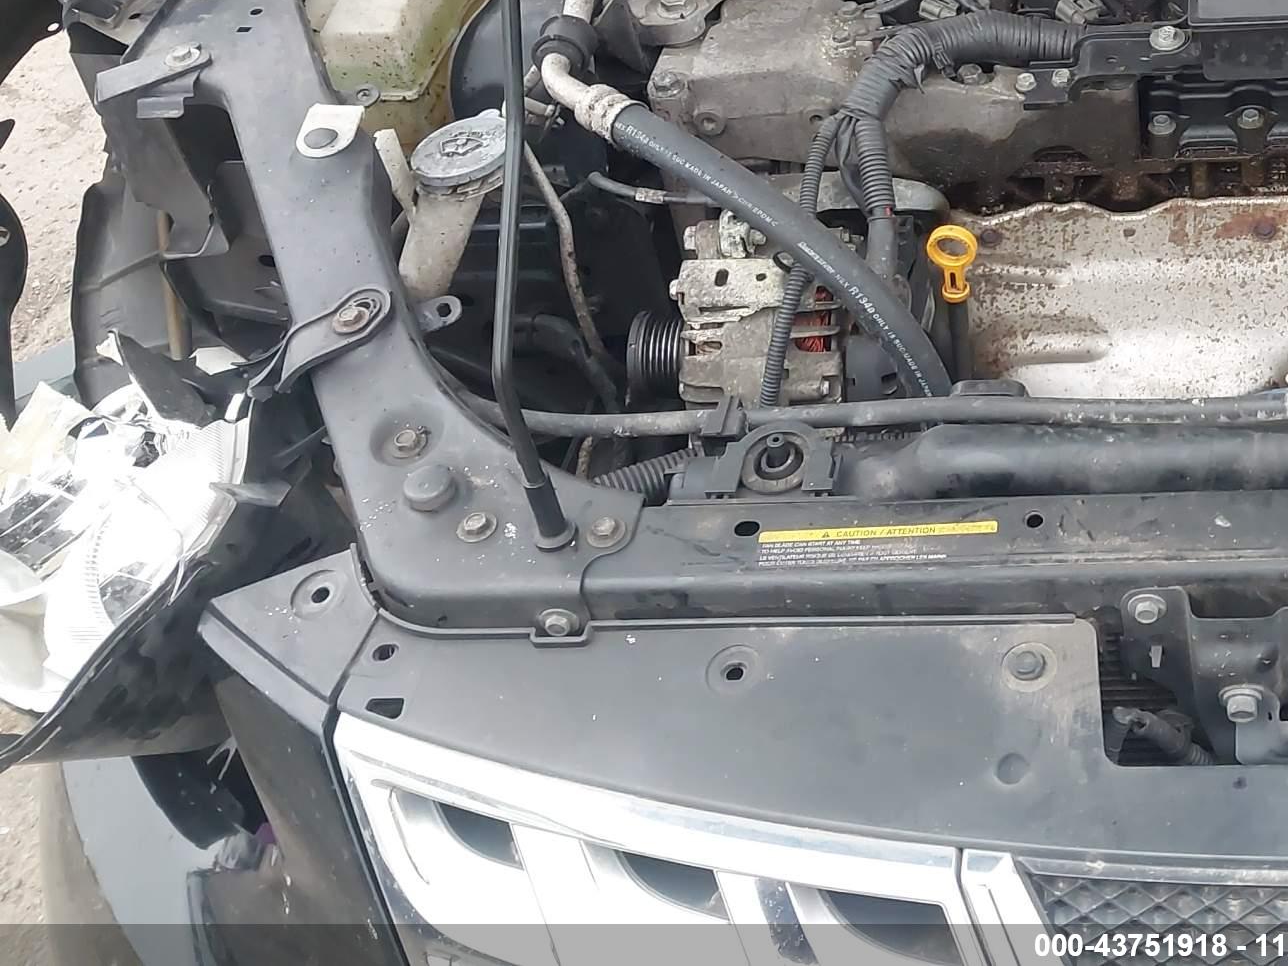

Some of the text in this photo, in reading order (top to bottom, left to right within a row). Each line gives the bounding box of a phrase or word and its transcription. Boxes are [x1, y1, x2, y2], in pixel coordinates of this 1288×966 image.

[685, 161, 703, 177] MADE
[710, 178, 733, 197] JAPAN
[872, 312, 890, 331] ONLY
[836, 529, 878, 538] CAUTION
[886, 526, 936, 535] ATTENTION
